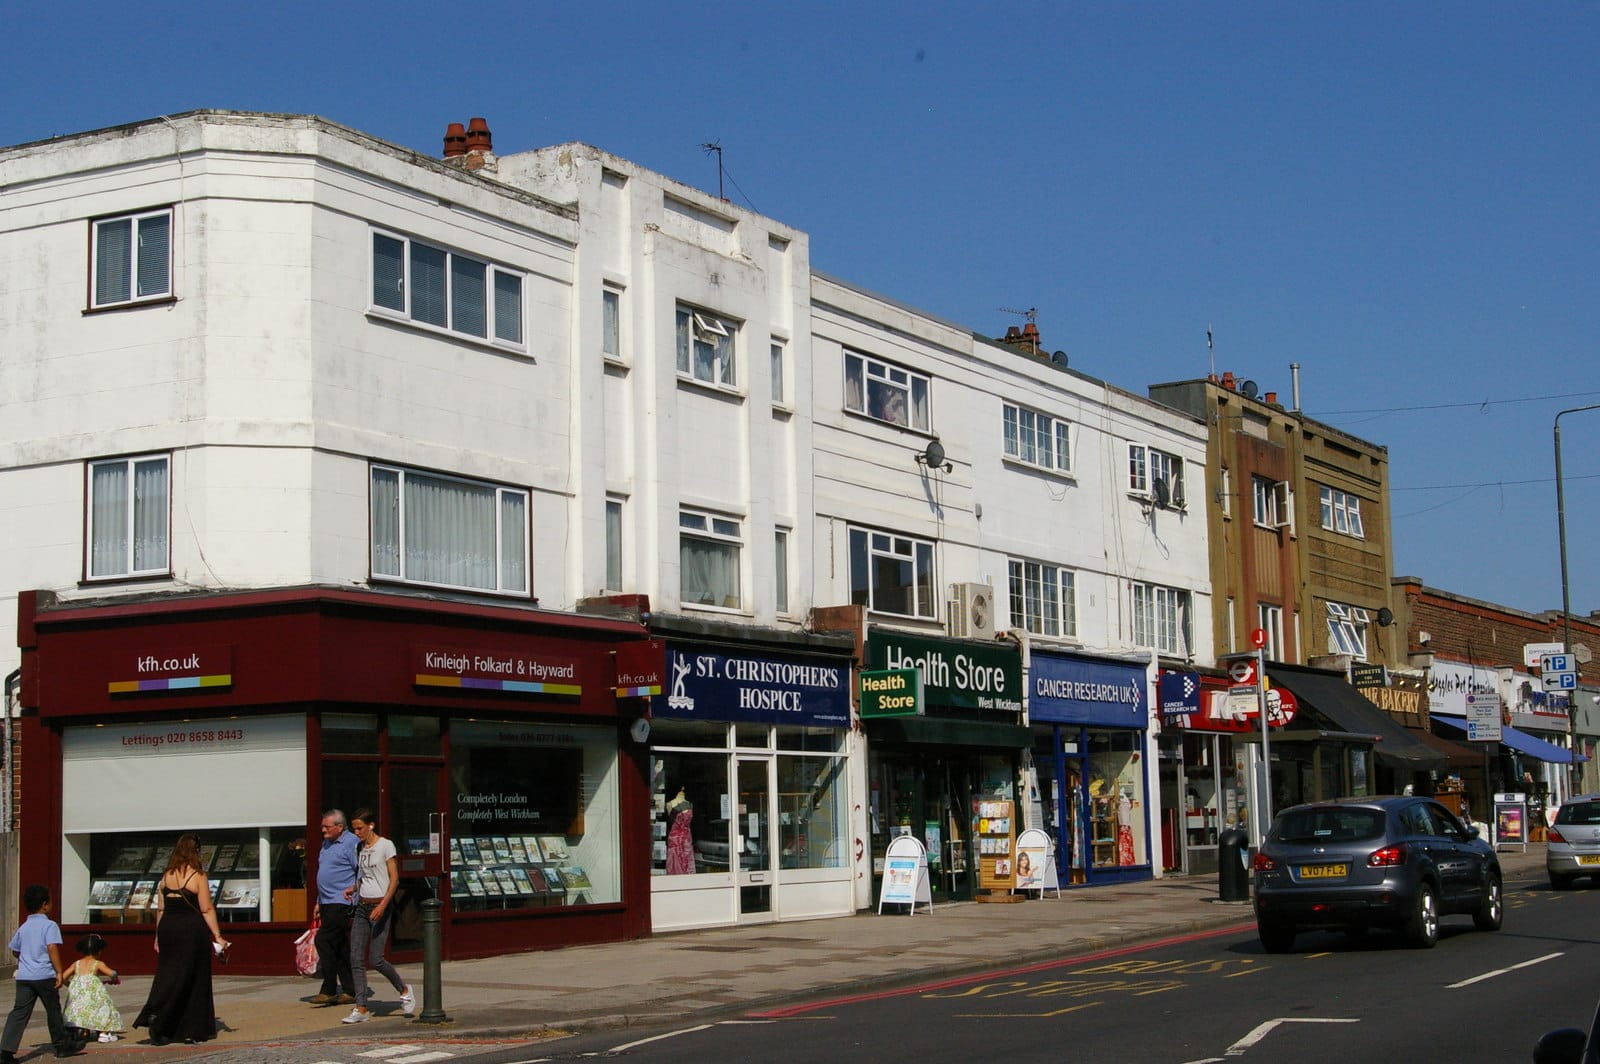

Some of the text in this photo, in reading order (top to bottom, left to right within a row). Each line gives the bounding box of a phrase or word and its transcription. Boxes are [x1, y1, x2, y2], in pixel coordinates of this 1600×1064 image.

[1255, 630, 1263, 644] J
[137, 652, 200, 673] kfh.co.uk
[425, 652, 574, 680] Kinleigh Folkard & Hayward
[1556, 657, 1564, 669] P
[618, 672, 658, 685] kfh.co.uk
[696, 655, 839, 689] ST. CHRISTOPHER'S
[955, 654, 1005, 693] Store
[862, 675, 905, 691] Health
[1563, 675, 1571, 687] P
[1037, 678, 1133, 704] CANCER RESEARCH UK
[739, 687, 802, 712] HOSPICE
[878, 695, 915, 709] Store
[978, 696, 1021, 711] West Wickham
[1381, 687, 1420, 714] BAKERY
[122, 729, 243, 747] Lettings 020 8658 8443
[457, 793, 527, 806] Completely London
[457, 809, 493, 822] Completely
[494, 809, 509, 819] West
[1301, 864, 1345, 876] LV07 FLZ
